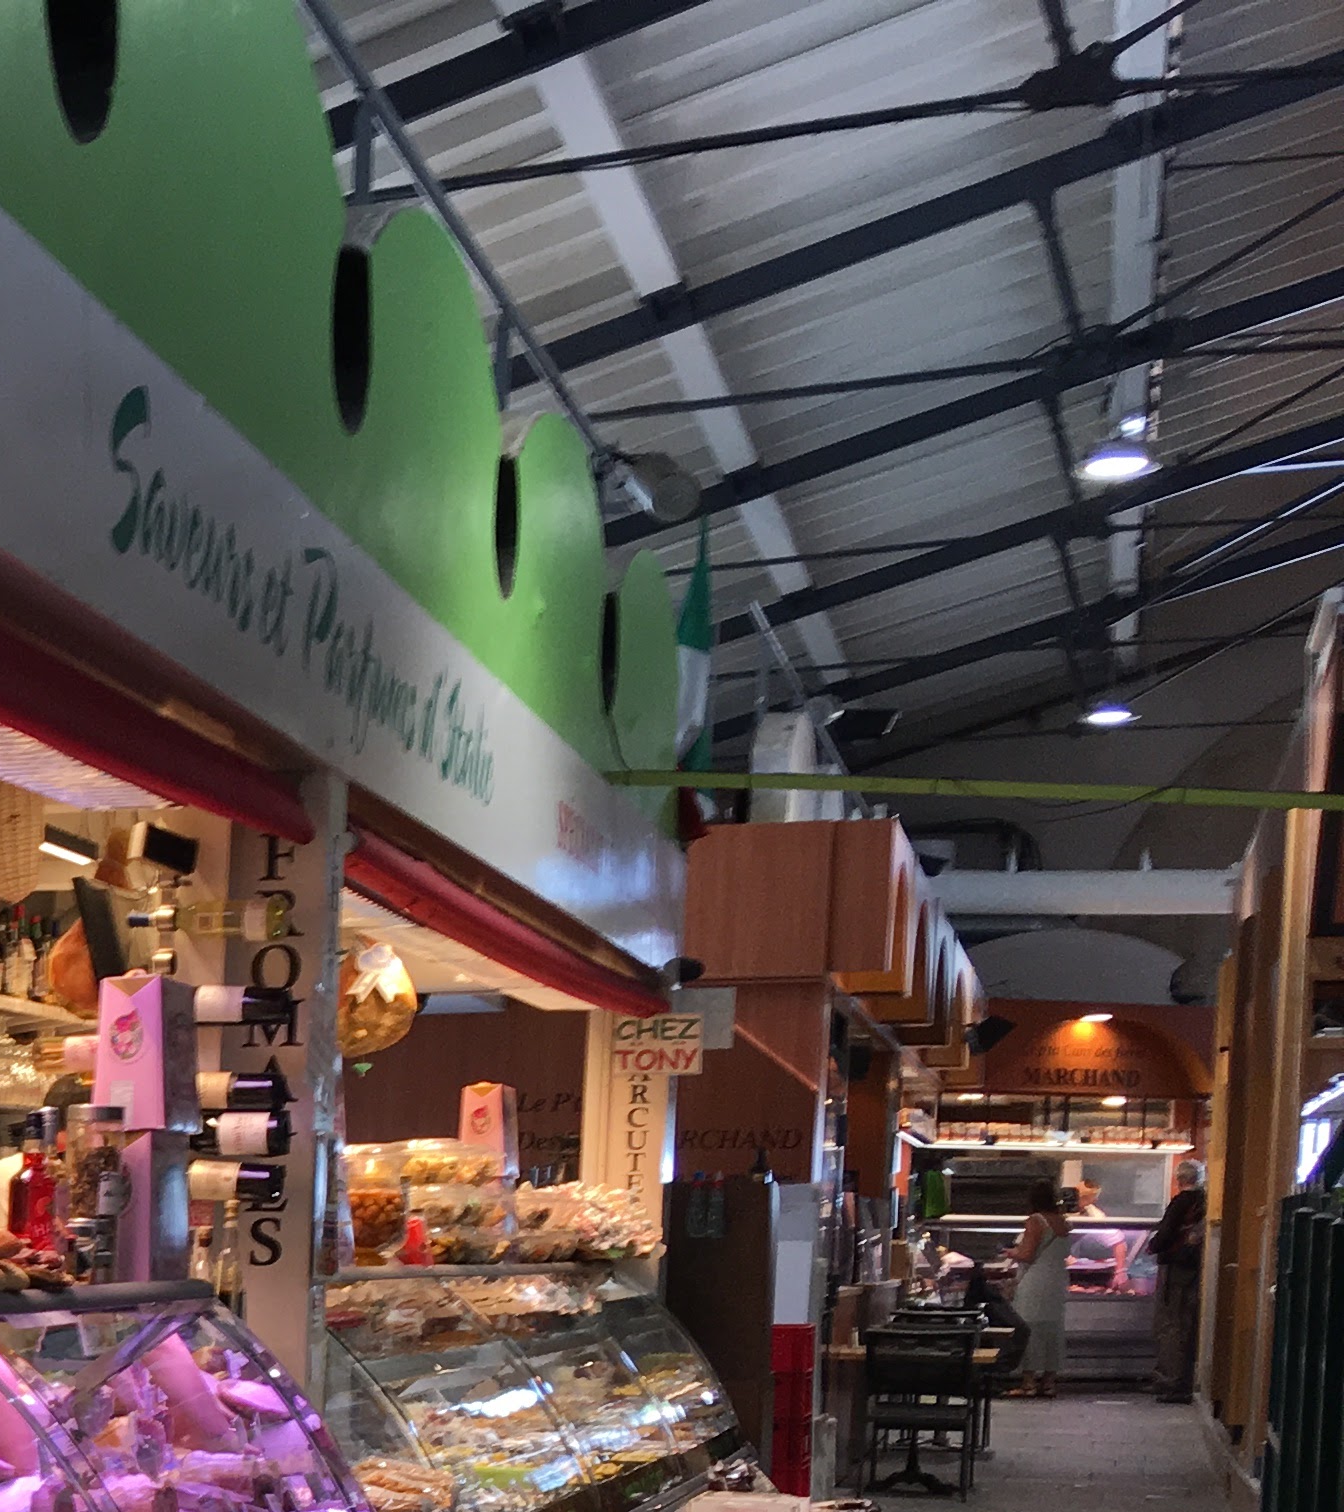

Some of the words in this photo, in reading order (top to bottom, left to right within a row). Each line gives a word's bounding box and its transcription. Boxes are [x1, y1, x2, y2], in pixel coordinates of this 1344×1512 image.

[616, 1017, 701, 1041] CHEZ
[615, 1048, 698, 1071] TONY
[1023, 1066, 1141, 1088] MARCHAND
[681, 1128, 802, 1150] RCHAND
